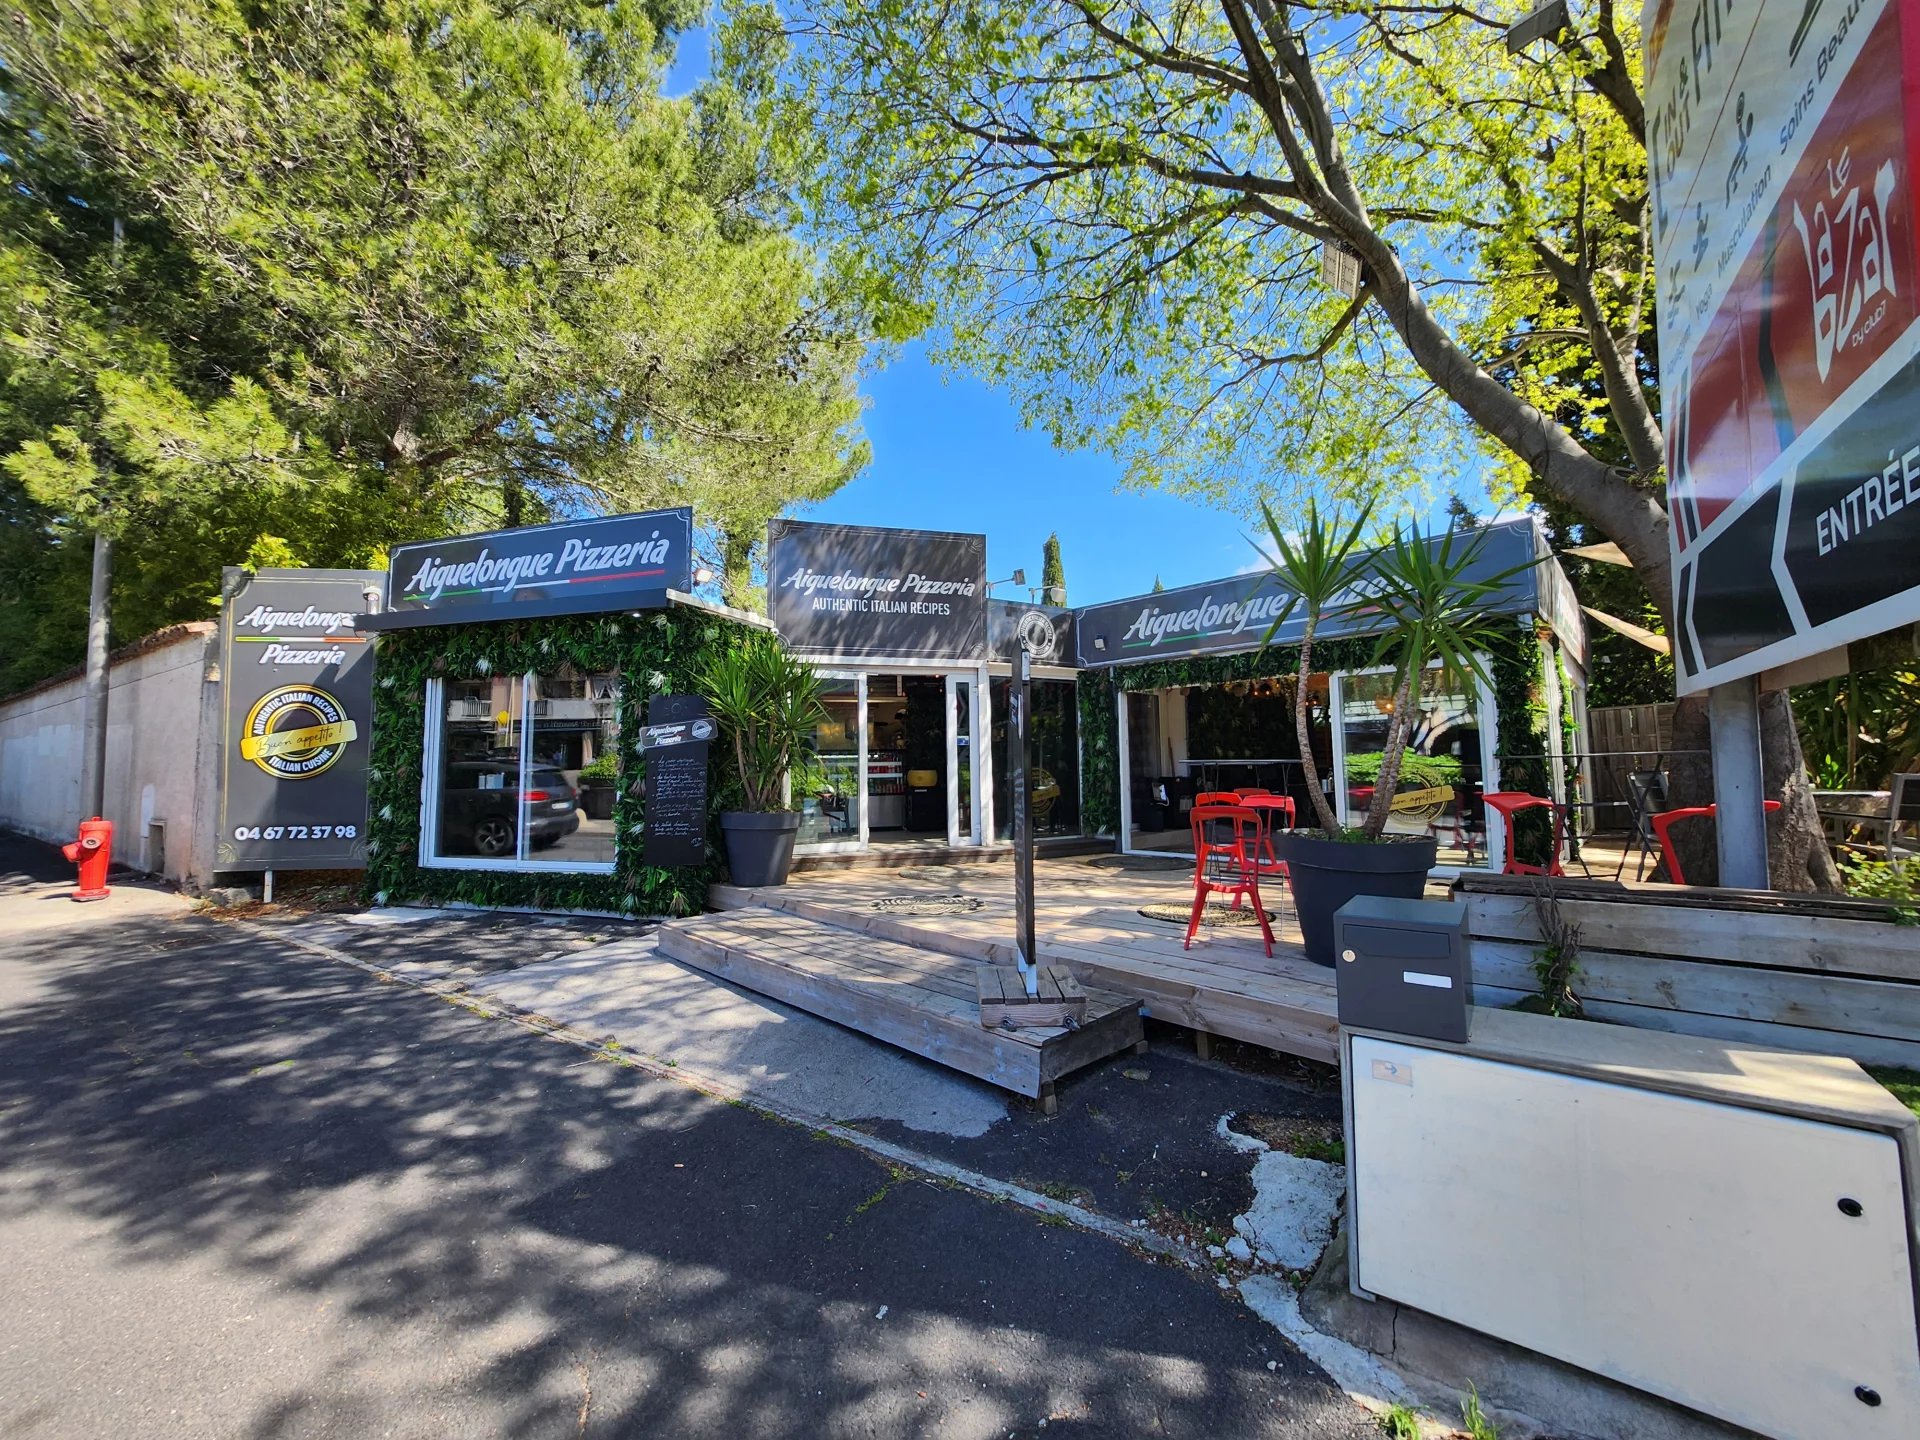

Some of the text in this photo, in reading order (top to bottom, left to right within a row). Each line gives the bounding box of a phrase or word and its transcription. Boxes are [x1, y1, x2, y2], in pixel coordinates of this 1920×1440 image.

[1716, 165, 1771, 279] Musculation
[1816, 445, 1920, 557] ENTRÉE
[404, 530, 670, 600] Aiguelongue Pizzeria
[781, 567, 976, 598] Aiguelongue Pizzeria
[812, 597, 950, 615] AUTHENTIC ITALIAN RECIPES
[1123, 595, 1290, 647] Aiguelongue
[259, 644, 346, 665] Pizzeria
[253, 692, 338, 735] AUTHENTIC ITALIAN RECIPES
[268, 748, 333, 772] ITALIAN CUISINE
[234, 825, 356, 840] 04 67 72 37 98
